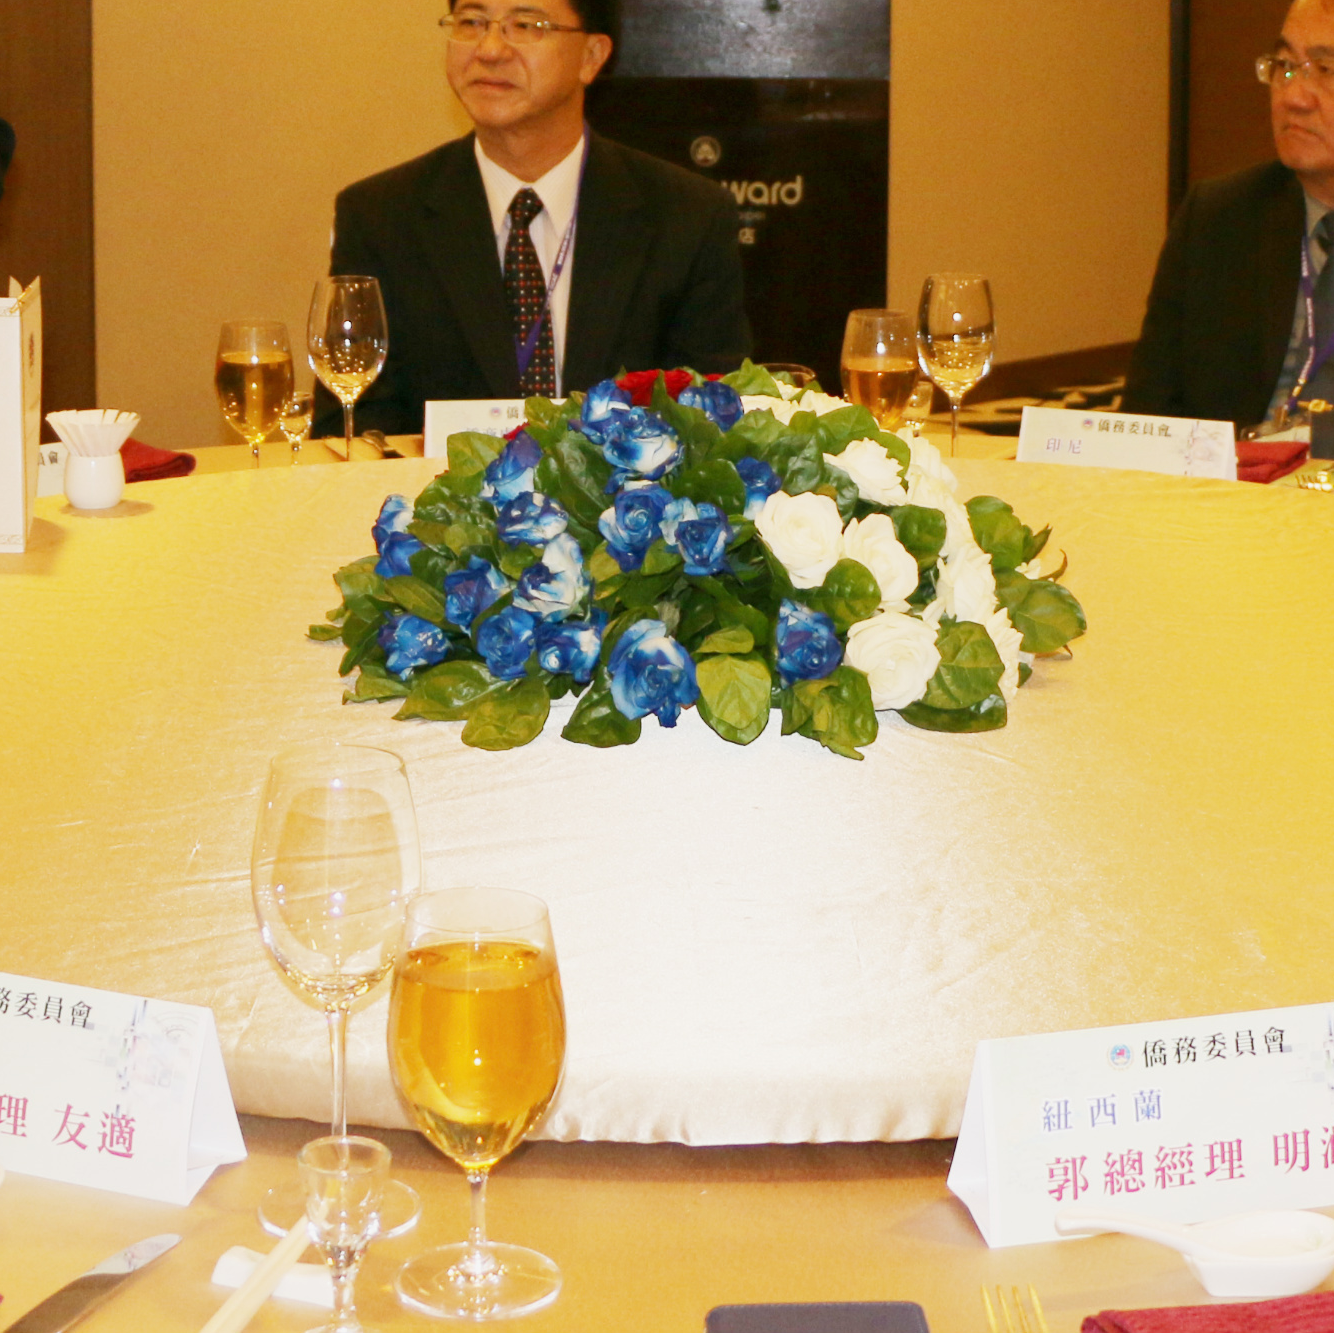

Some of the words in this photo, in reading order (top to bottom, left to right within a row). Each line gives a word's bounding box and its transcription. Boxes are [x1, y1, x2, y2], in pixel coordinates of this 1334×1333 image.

[1142, 1026, 1288, 1068] 僑務委員會
[51, 1102, 137, 1159] 友適
[1041, 1089, 1164, 1134] 紐西蘭
[1045, 1137, 1247, 1203] 郭總經理
